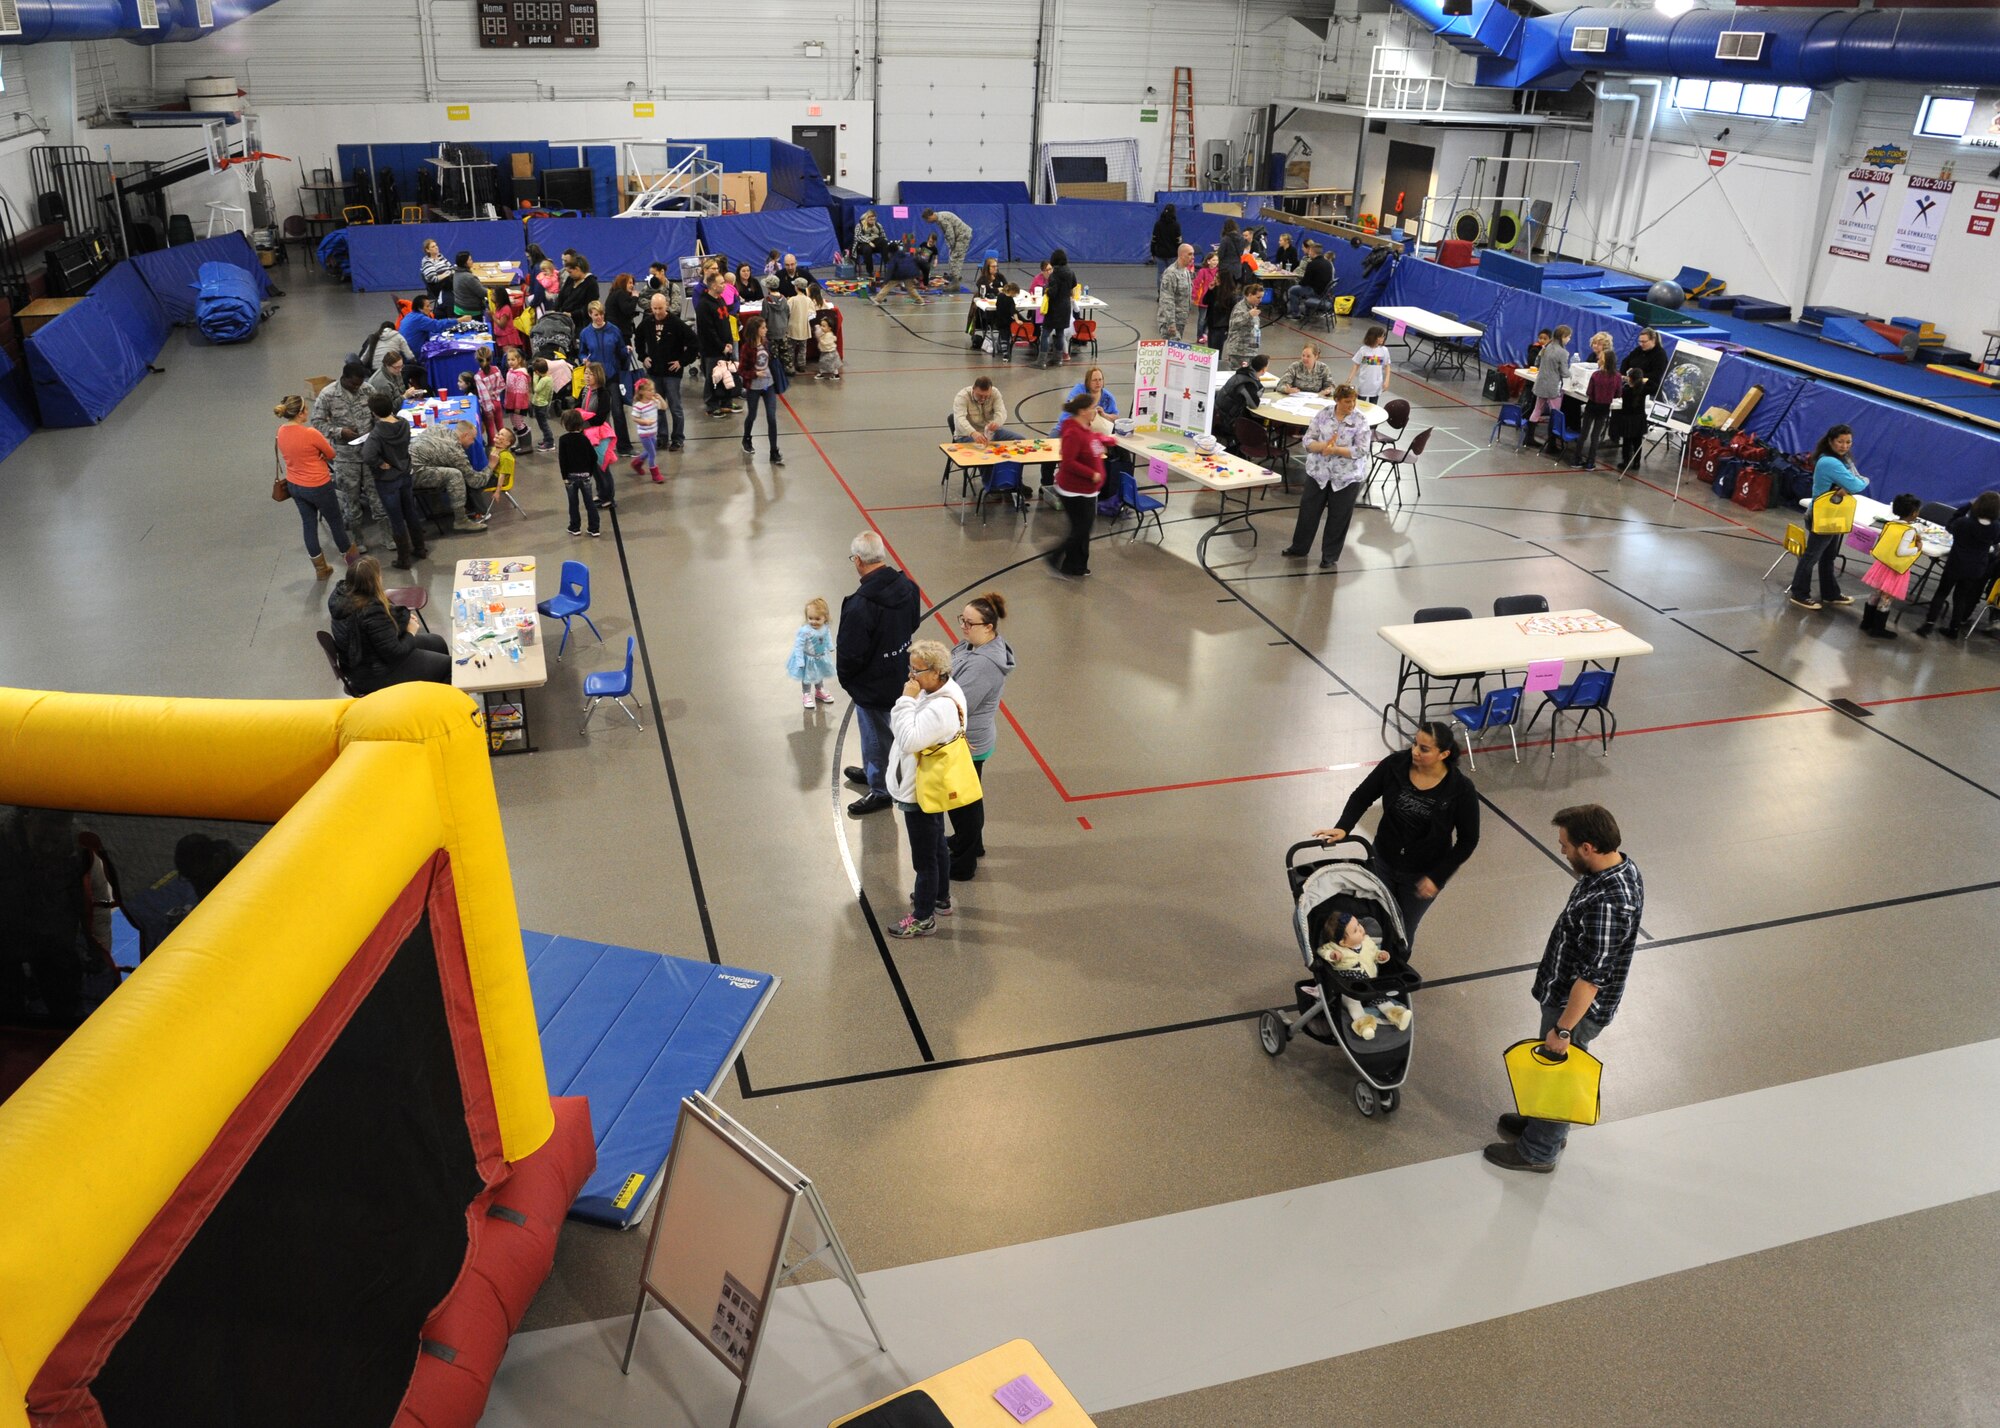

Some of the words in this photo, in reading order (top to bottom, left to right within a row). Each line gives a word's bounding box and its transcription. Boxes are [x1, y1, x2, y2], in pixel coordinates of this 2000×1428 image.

[483, 4, 504, 13] Home
[569, 4, 594, 13] Guests
[528, 35, 552, 45] period
[1970, 138, 1999, 148] LEVEL
[1850, 168, 1891, 183] 2015-2016
[1911, 176, 1953, 191] 2014-2015
[1839, 219, 1848, 227] USA
[1848, 221, 1876, 231] GYMNASTICS
[1897, 228, 1907, 236] USA
[1907, 230, 1937, 241] GYMNASTICS
[1900, 242, 1916, 251] MEMBER
[1888, 256, 1928, 270] USAGymClub.com
[1138, 347, 1163, 357] Grand
[1167, 347, 1185, 360] Play
[1138, 358, 1161, 366] Forks
[1139, 366, 1159, 375] CDC
[718, 973, 760, 984] AMERICAN
